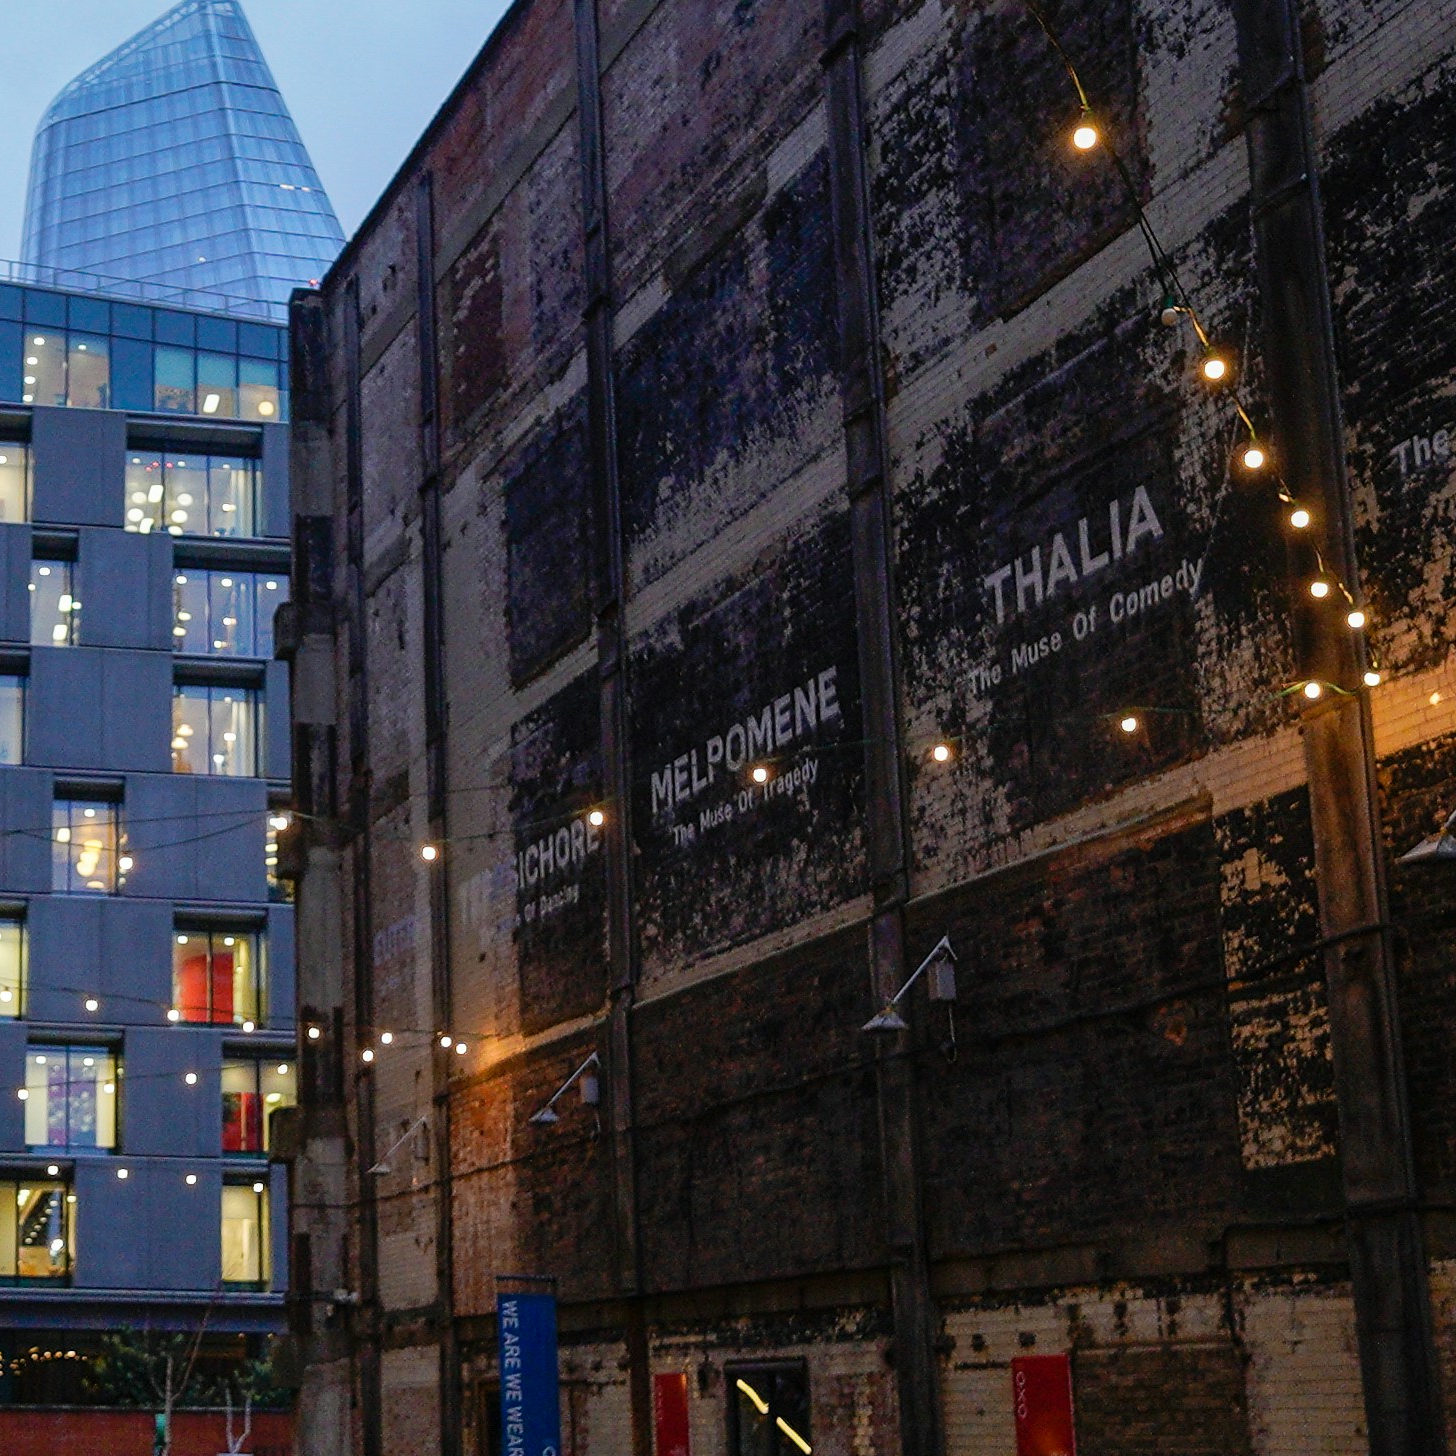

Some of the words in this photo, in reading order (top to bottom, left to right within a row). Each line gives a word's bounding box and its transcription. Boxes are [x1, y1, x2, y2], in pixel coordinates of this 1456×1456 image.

[1393, 428, 1450, 475] The
[984, 485, 1164, 625] THALIA
[968, 662, 1003, 694] The
[1011, 632, 1063, 676] Muse
[1072, 604, 1097, 641] Of
[1109, 557, 1204, 625] Comedy
[650, 664, 842, 815] MELPOMENE
[671, 822, 695, 847] The
[699, 803, 733, 834] Muse
[738, 788, 753, 814] Of
[762, 757, 820, 802] Tragedy
[502, 1300, 519, 1330] WE
[503, 1332, 522, 1370] ARE
[505, 1373, 523, 1402] WE
[1015, 1371, 1028, 1419] OXO
